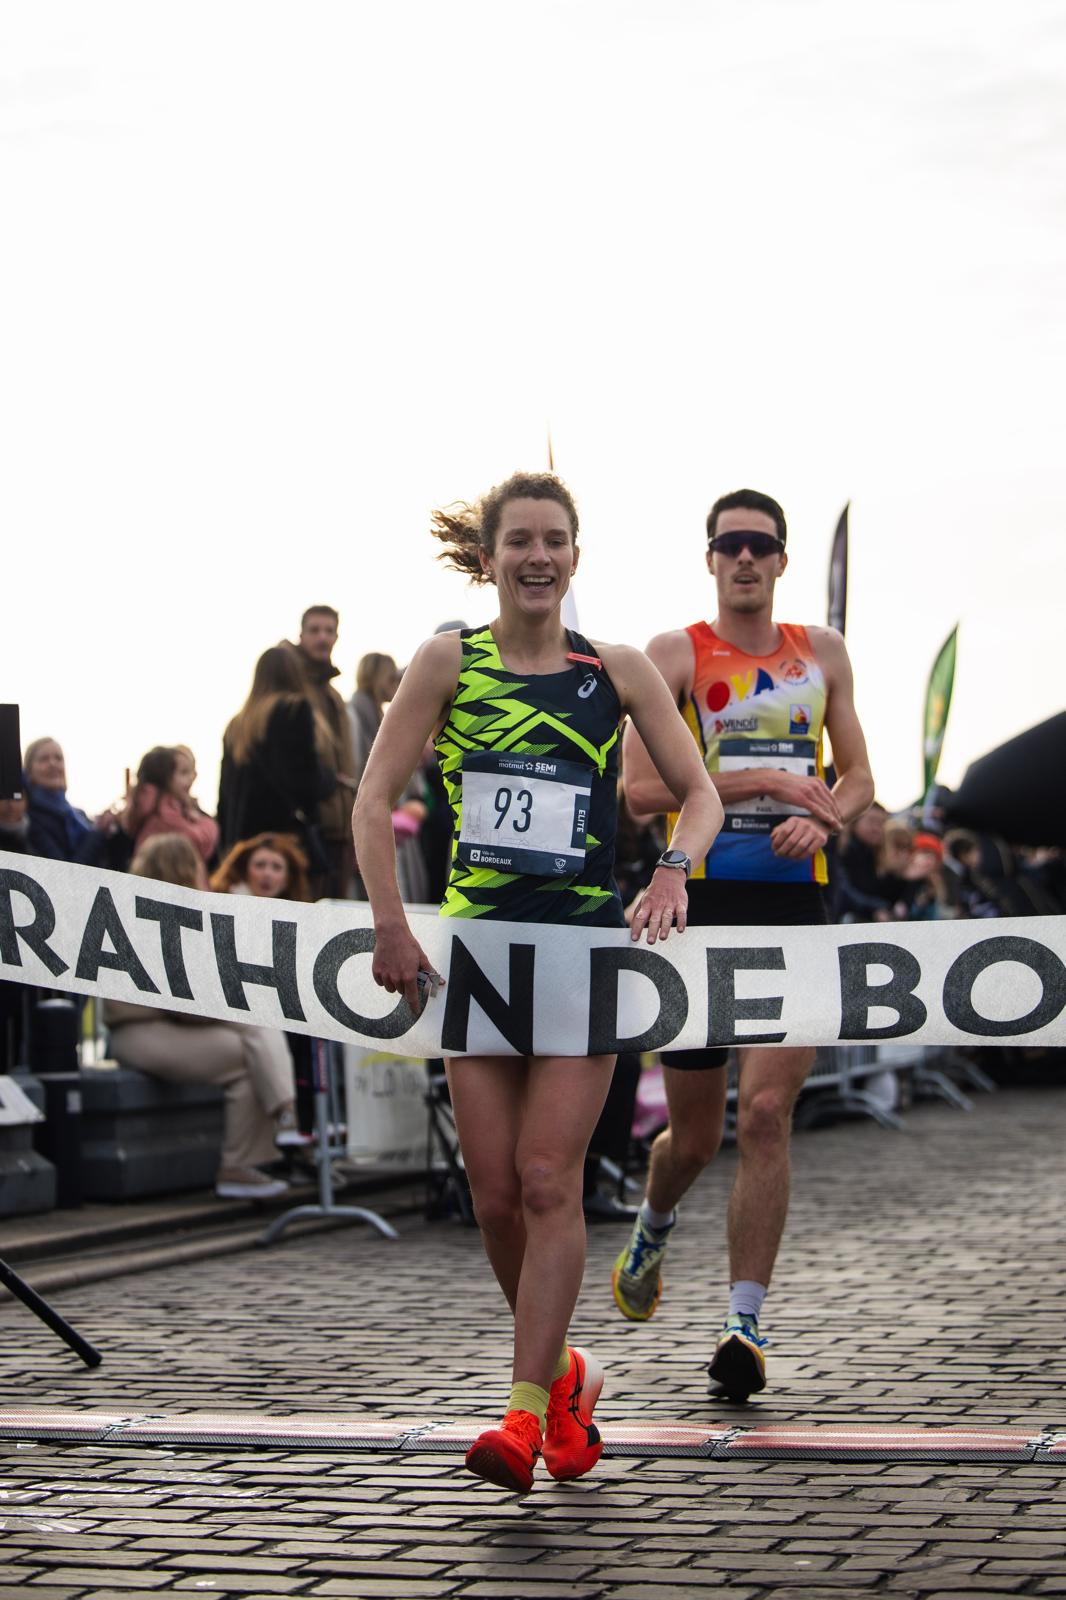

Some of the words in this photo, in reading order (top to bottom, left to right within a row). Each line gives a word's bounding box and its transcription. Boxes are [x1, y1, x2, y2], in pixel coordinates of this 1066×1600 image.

[535, 762, 557, 772] SEMI
[494, 787, 533, 833] 93
[576, 809, 585, 832] ELITE
[480, 856, 512, 865] BORDEAUX
[587, 946, 787, 1055] DE
[838, 935, 1066, 1039] BO
